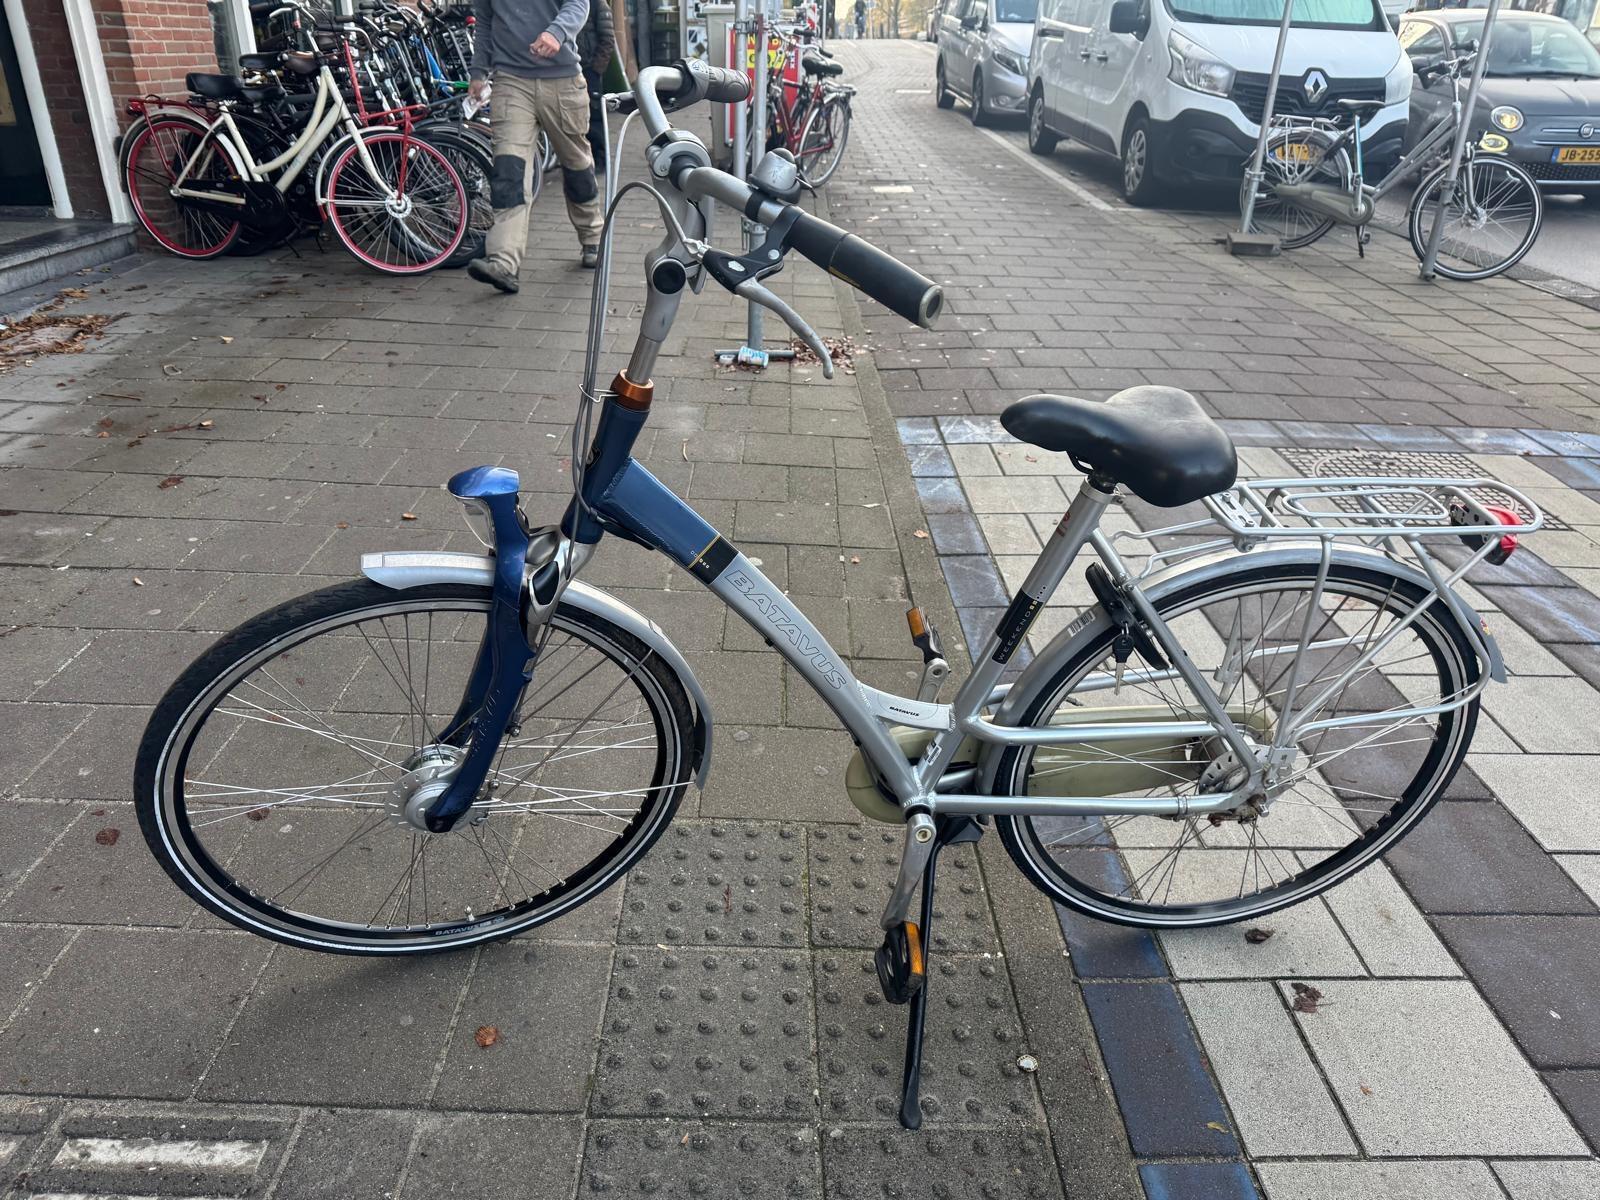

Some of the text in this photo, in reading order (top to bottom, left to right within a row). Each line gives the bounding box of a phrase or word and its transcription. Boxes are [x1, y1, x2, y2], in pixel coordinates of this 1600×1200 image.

[724, 570, 847, 690] BATAVUS
[998, 611, 1032, 661] WEEKEND
[889, 706, 920, 717] BATAVUS
